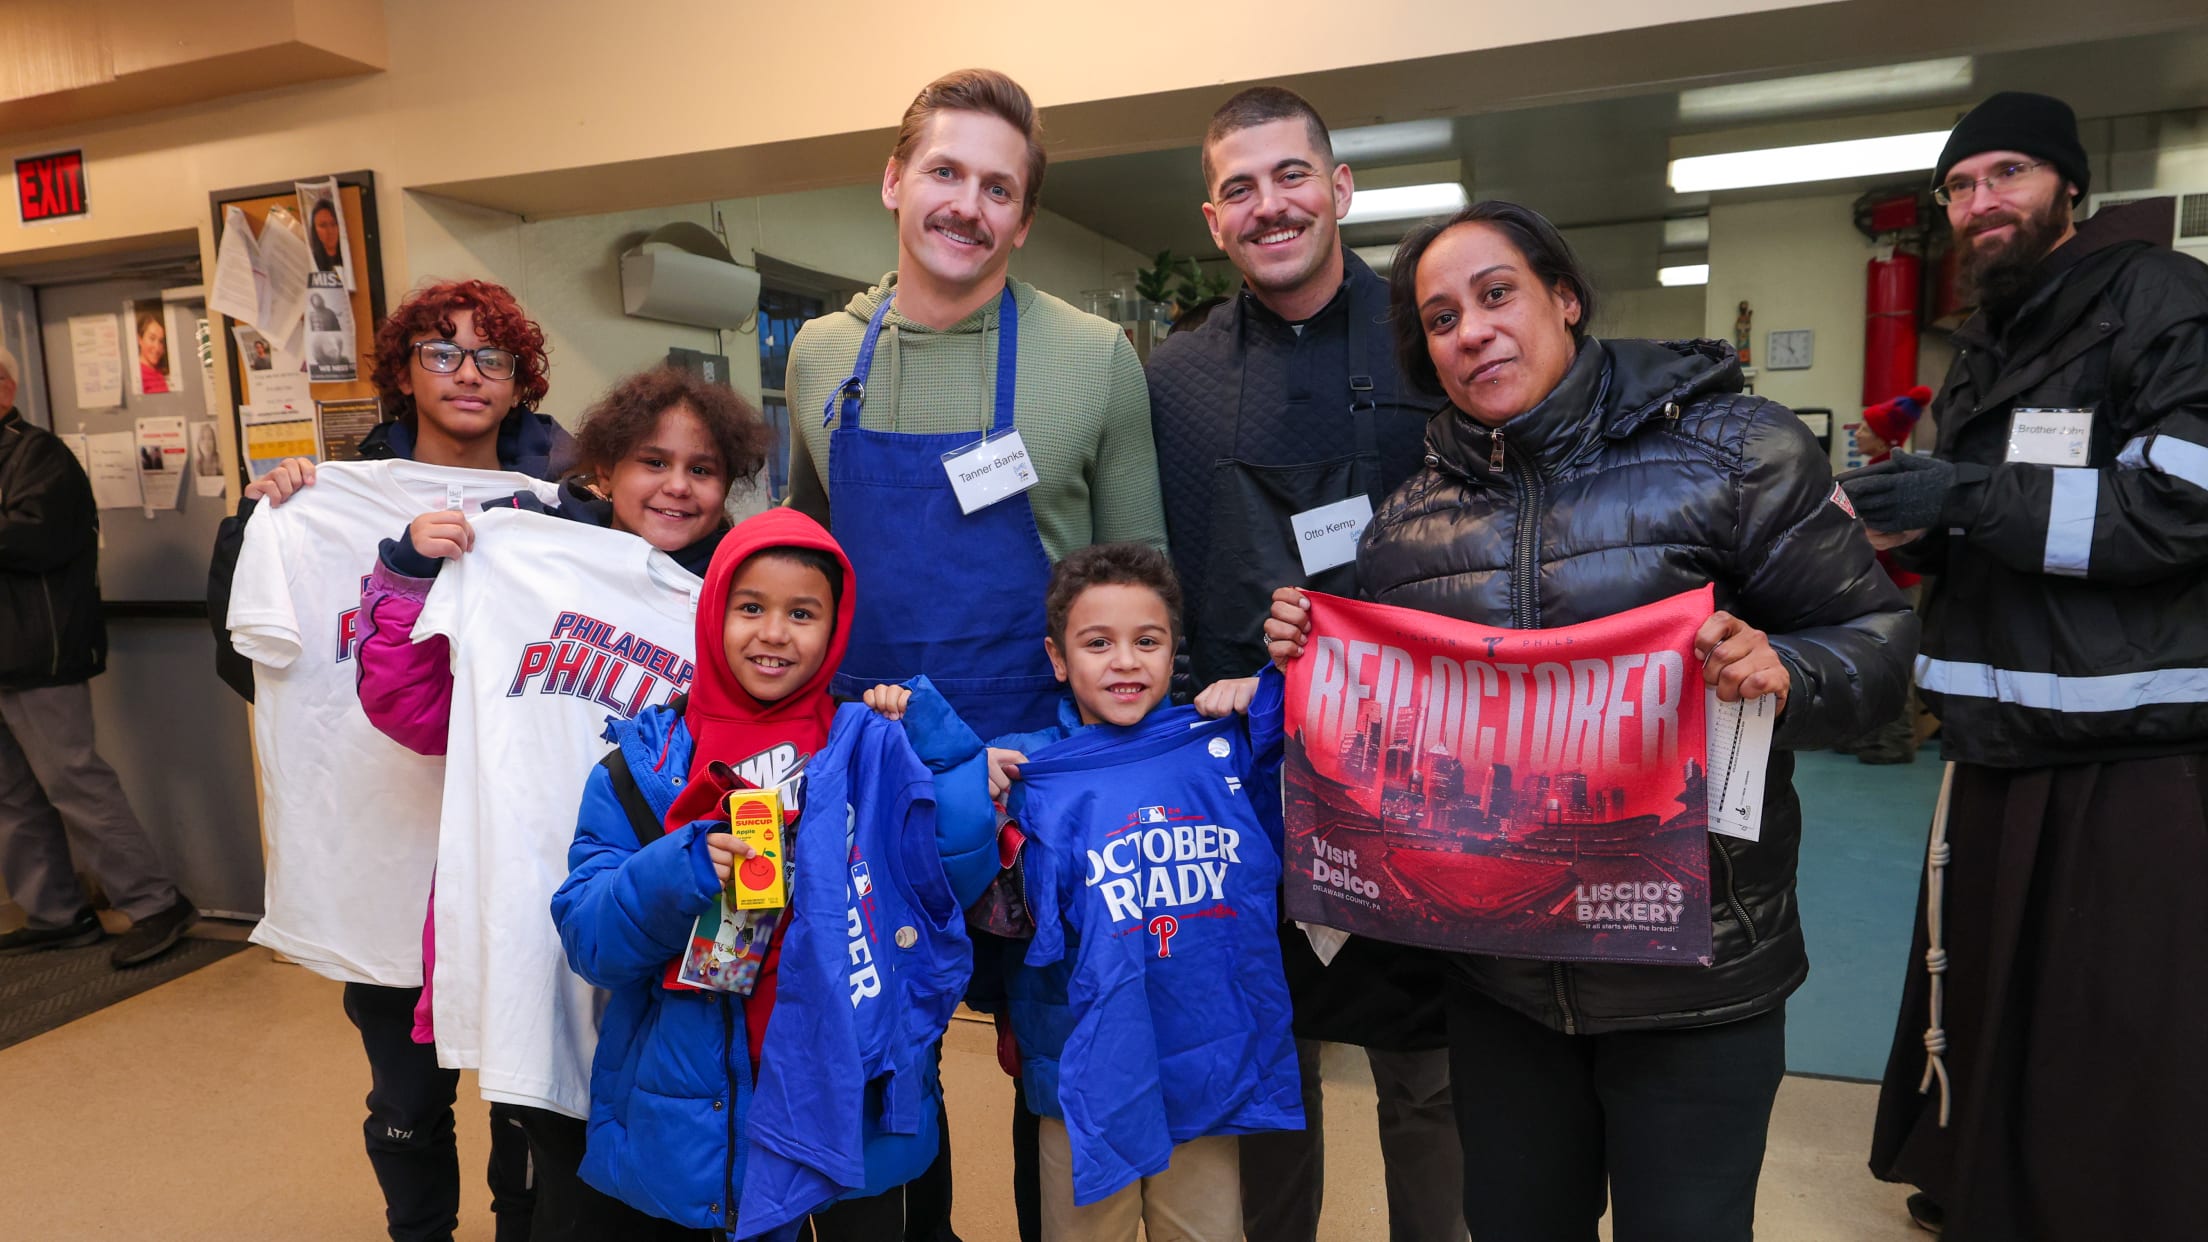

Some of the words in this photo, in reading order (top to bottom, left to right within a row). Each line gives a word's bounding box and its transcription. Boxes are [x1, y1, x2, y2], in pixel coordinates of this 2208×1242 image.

[17, 154, 81, 219] EXIT
[2018, 424, 2057, 434] Brother
[958, 463, 992, 483] Tanner
[993, 449, 1025, 469] Banks
[1304, 528, 1324, 541] Otto
[1325, 519, 1356, 534] Kemp
[550, 611, 696, 688] PHILADELP
[1522, 637, 1574, 648] PHILS
[506, 640, 684, 721] PHILL
[1306, 636, 1414, 750] RED
[1422, 650, 1684, 770] OCTOBER
[735, 818, 773, 827] SUNCUP
[1085, 824, 1242, 888] OCTOBER
[1311, 835, 1358, 870] Visit
[1313, 858, 1380, 899] Delco
[1576, 881, 1684, 903] LISCIO'S
[1312, 884, 1345, 899] DELAWARE
[1372, 902, 1381, 911] PA
[1576, 902, 1685, 924] BAKERY
